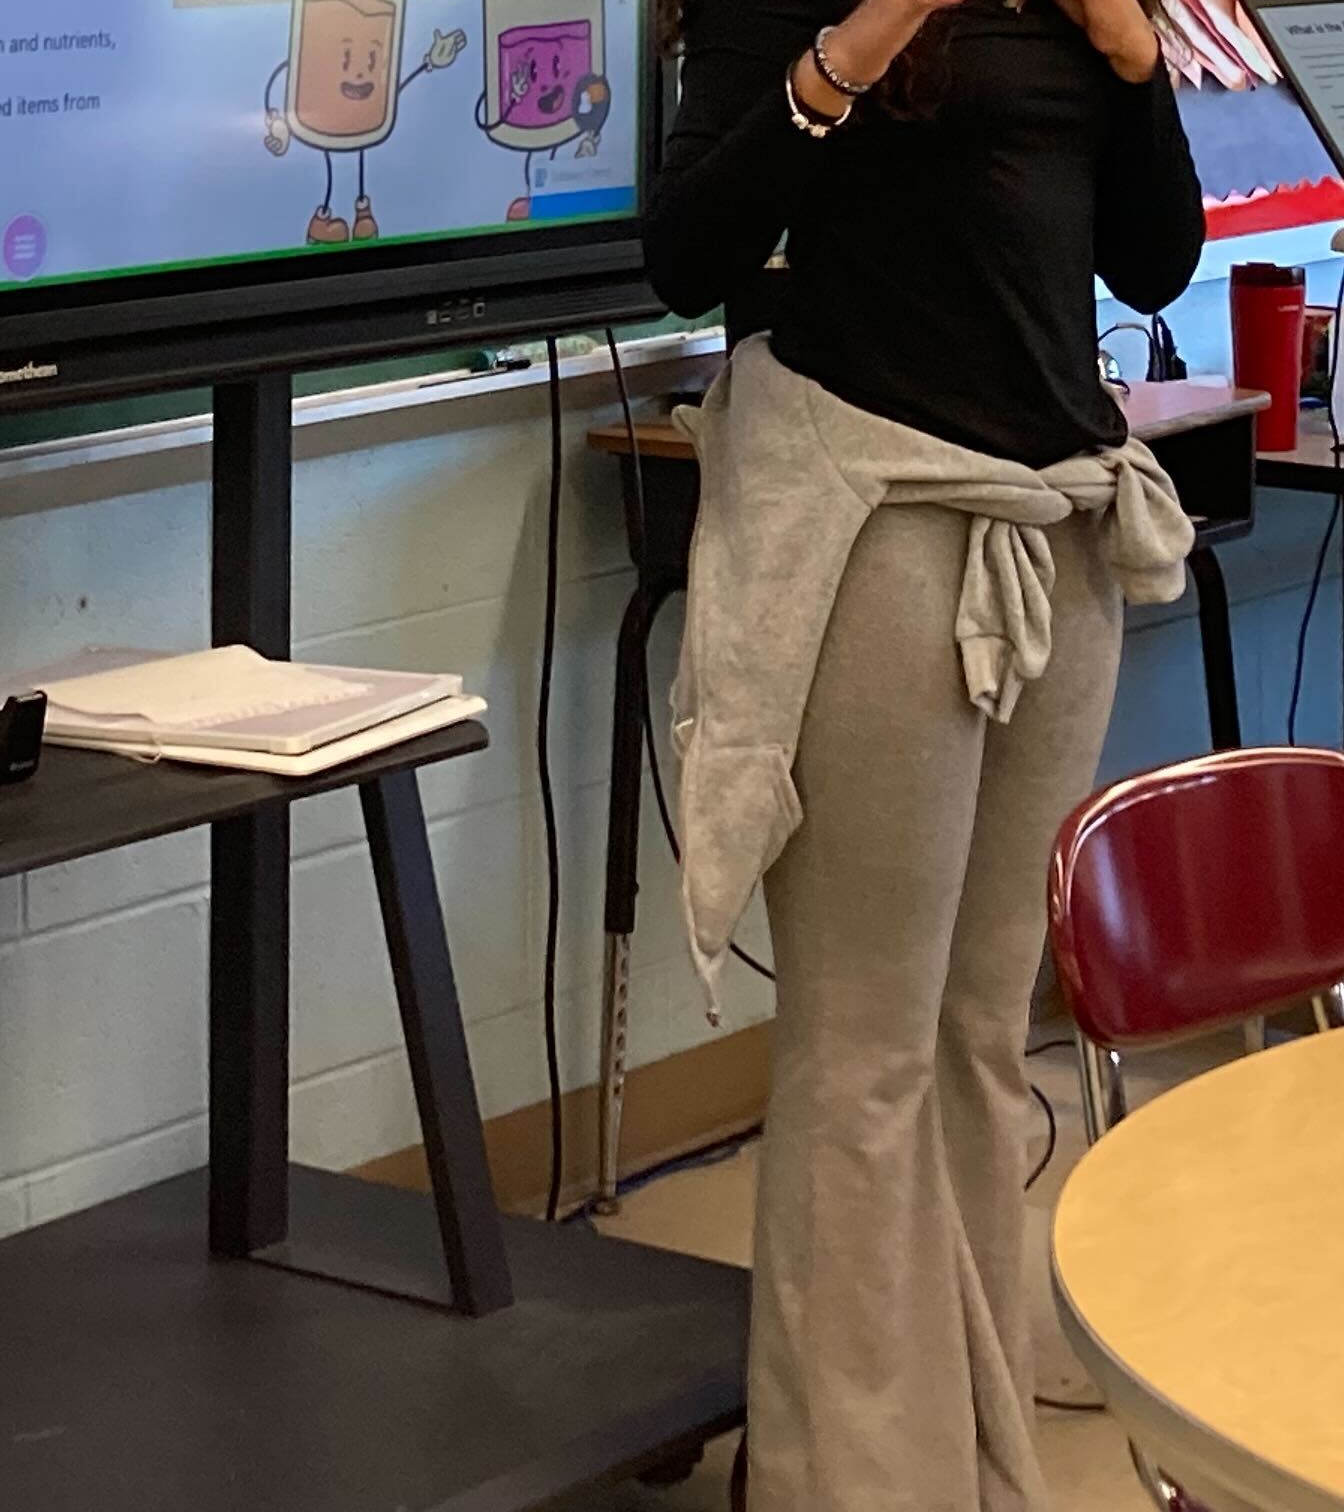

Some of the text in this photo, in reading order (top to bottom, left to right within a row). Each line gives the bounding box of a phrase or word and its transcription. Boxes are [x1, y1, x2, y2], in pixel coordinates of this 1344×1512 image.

[9, 32, 40, 53] and
[43, 29, 118, 52] nutrients,
[16, 95, 60, 116] items
[63, 92, 101, 112] from
